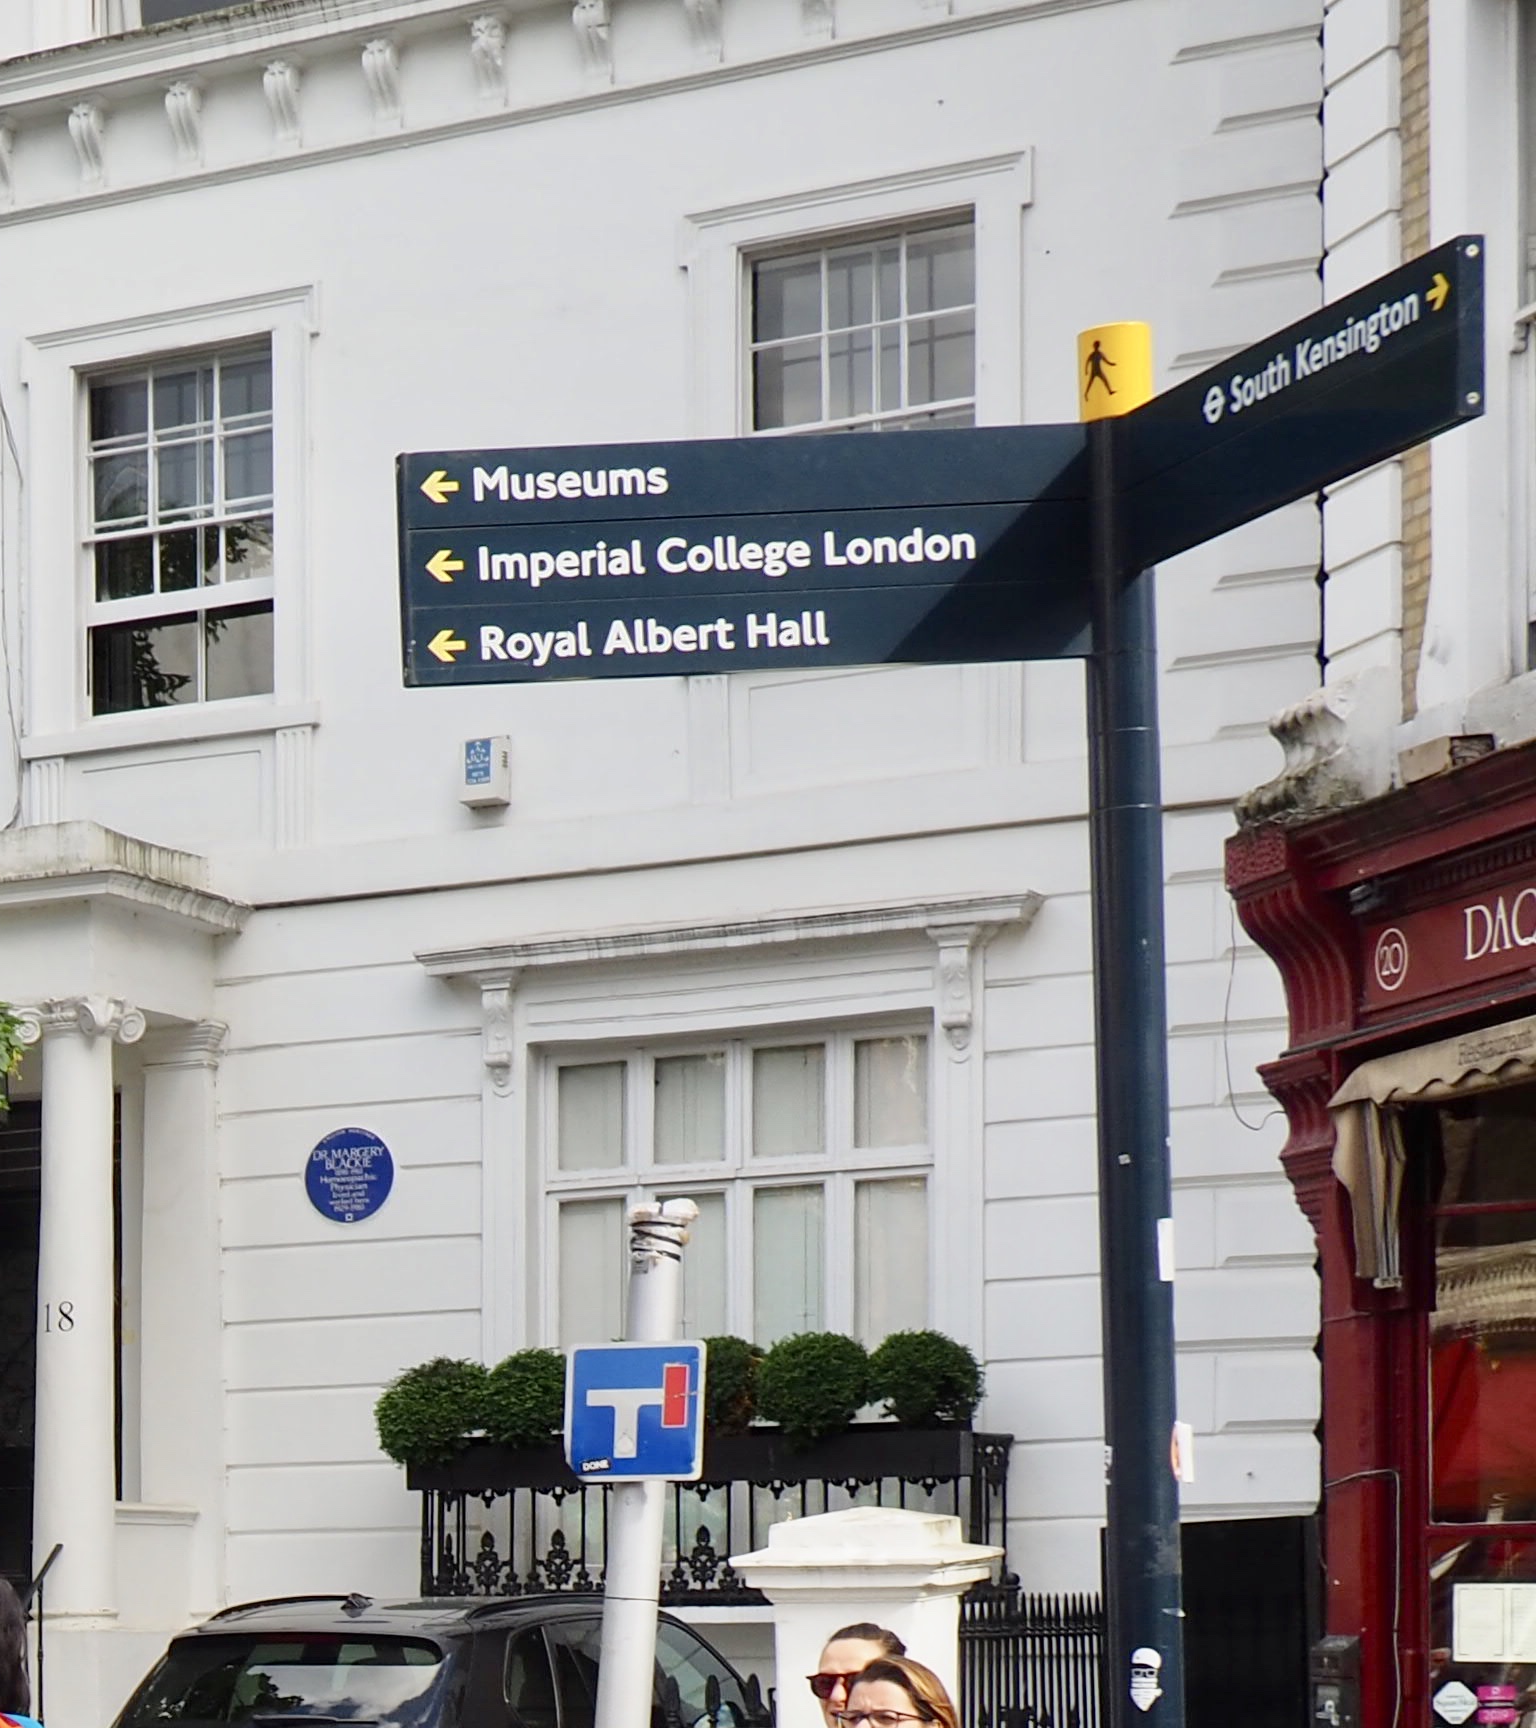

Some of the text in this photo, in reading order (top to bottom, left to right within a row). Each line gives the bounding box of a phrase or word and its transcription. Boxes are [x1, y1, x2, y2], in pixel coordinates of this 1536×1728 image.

[1230, 293, 1420, 413] South Kensington
[473, 466, 669, 502] Museums
[478, 527, 977, 588] Imperial College London
[479, 610, 830, 667] Royal Albert Hall
[1380, 943, 1403, 976] 20
[44, 1301, 74, 1333] 18
